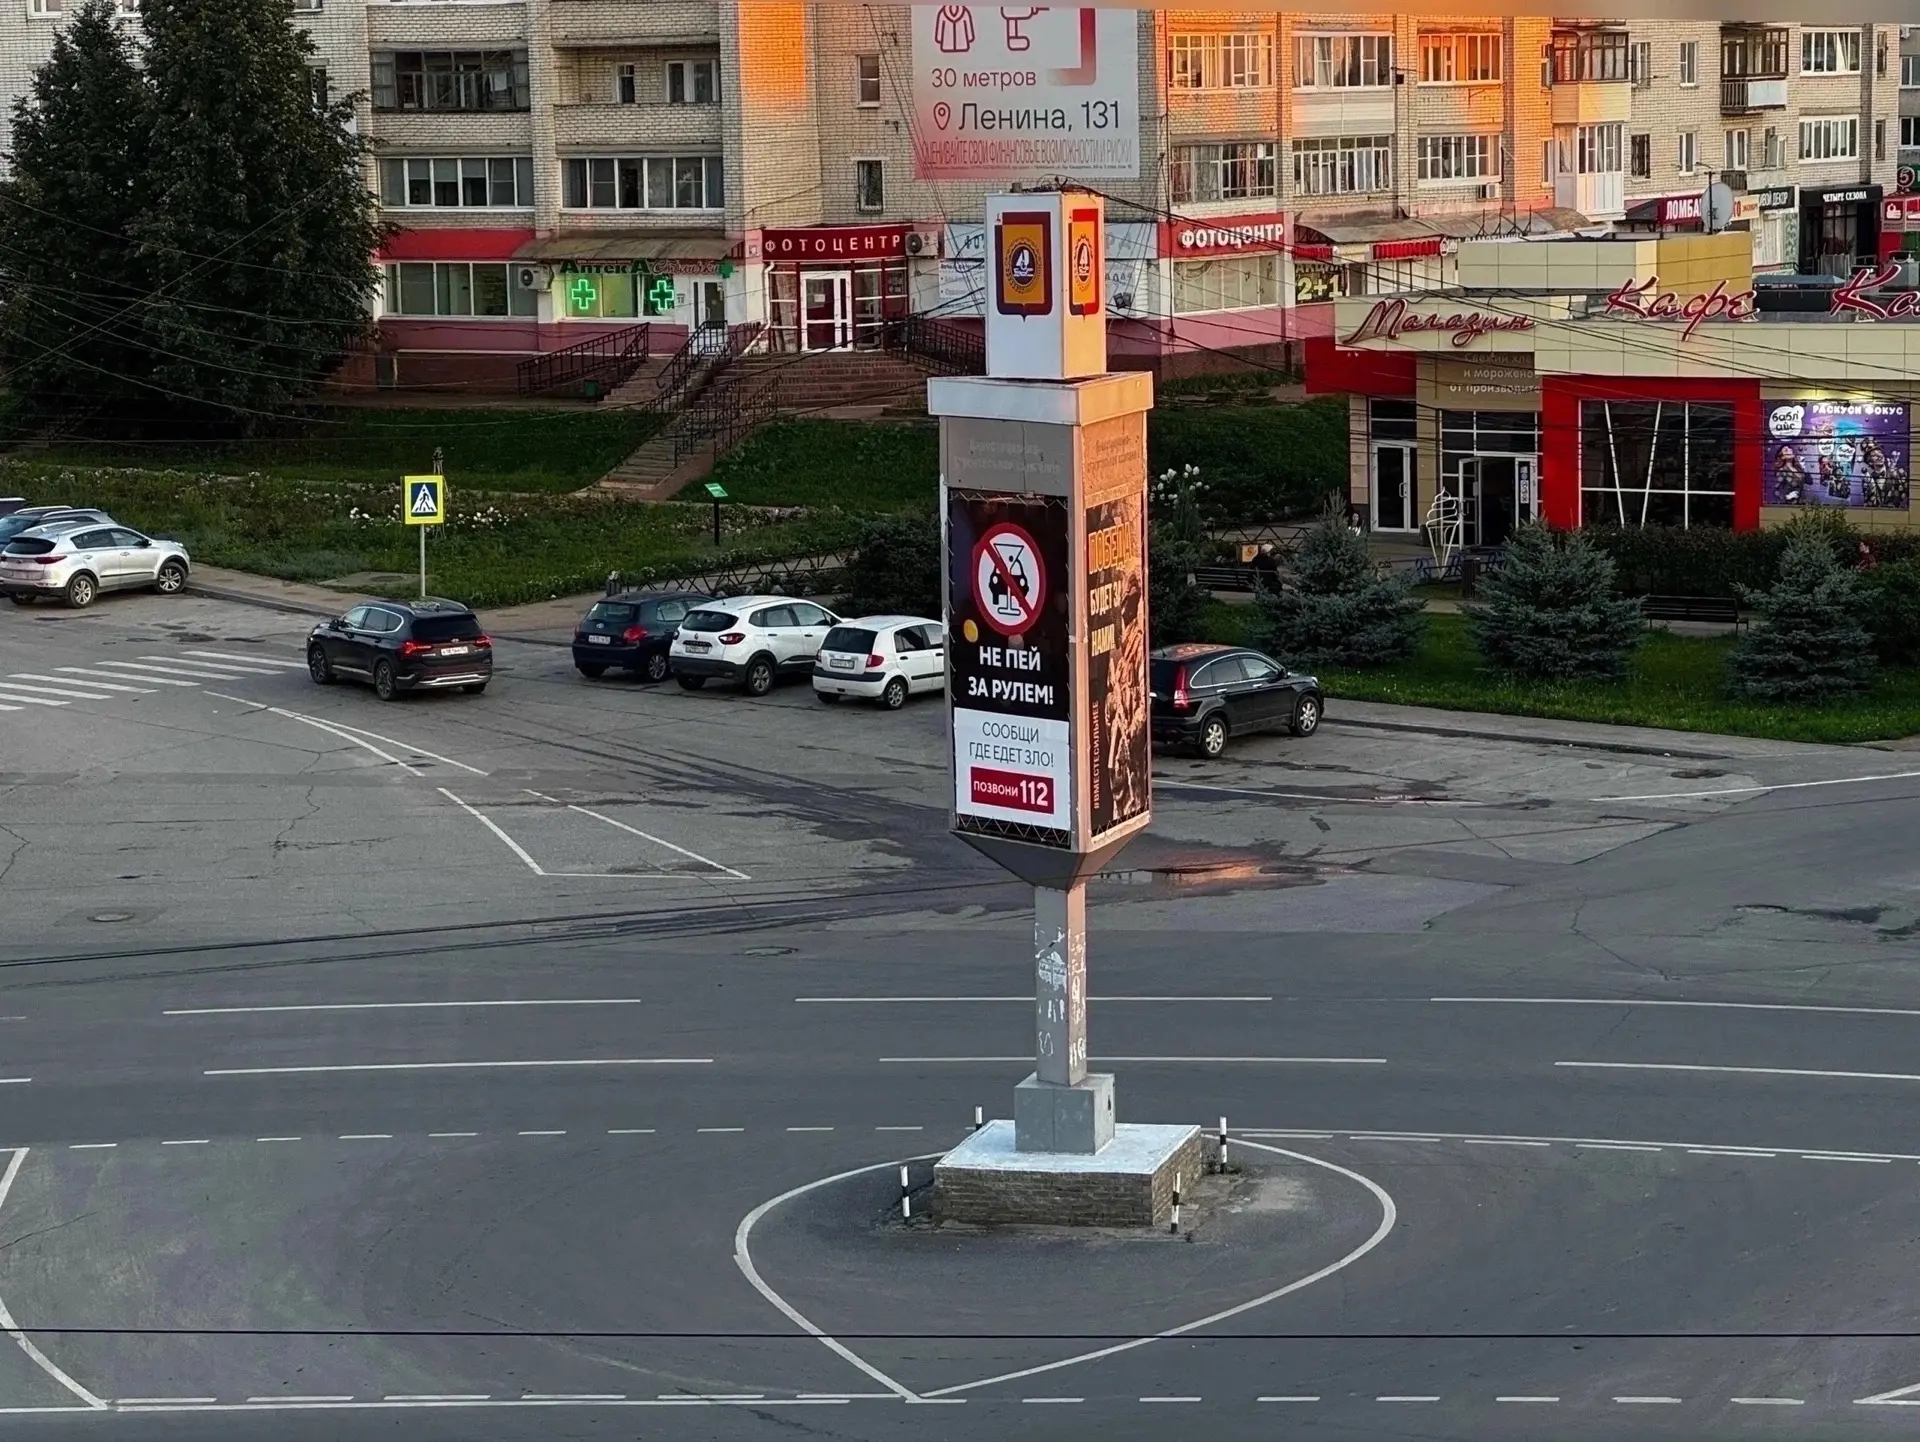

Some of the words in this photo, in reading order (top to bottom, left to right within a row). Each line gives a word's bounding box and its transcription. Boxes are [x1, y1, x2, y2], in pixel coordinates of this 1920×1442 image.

[931, 68, 957, 88] 30
[963, 71, 1037, 91] метров
[958, 102, 1073, 131] Ленина,
[1081, 101, 1119, 129] 131
[764, 234, 900, 253] ФОТОЦЕНТР
[1297, 274, 1343, 300] 2+1
[1604, 276, 1759, 342] Кафе
[1341, 298, 1537, 348] Магазин
[1812, 404, 1862, 415] РАСКУСИ
[1864, 405, 1904, 416] ФОКУС
[1775, 421, 1796, 431] айс
[1090, 583, 1113, 616] БУДЕТ
[979, 646, 1002, 667] НЕ
[1006, 646, 1041, 671] ПЕЙ
[968, 676, 989, 697] ЗА
[992, 679, 1054, 705] РУЛЕМ!
[982, 721, 1039, 744] СООБЩИ
[969, 742, 992, 760] ГДЕ
[993, 745, 1023, 765] ЕДЕТ
[1024, 748, 1054, 767] ЗЛО!
[1019, 779, 1049, 807] 112
